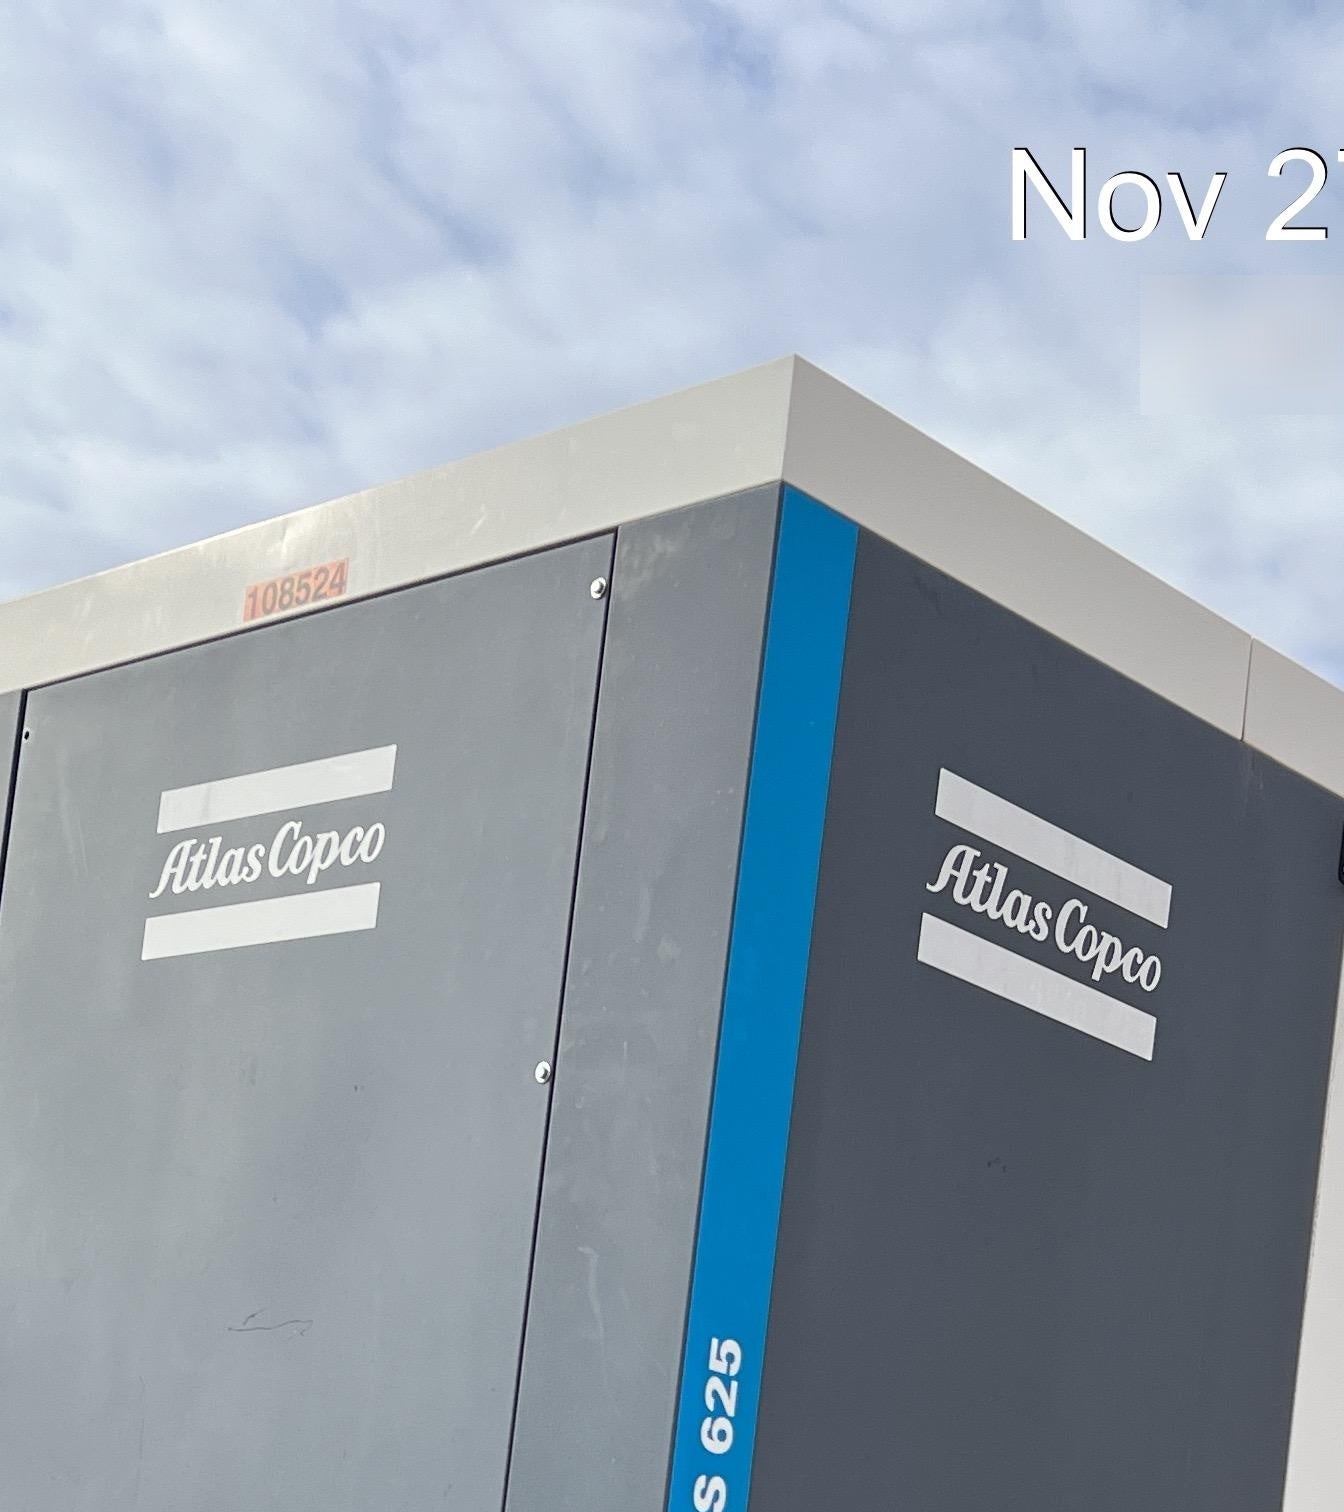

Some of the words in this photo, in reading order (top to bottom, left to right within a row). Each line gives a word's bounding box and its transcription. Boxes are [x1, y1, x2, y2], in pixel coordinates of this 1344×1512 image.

[246, 558, 348, 620] 108524
[148, 836, 265, 899] Atlas
[267, 820, 386, 885] Copco
[925, 843, 1053, 942] Atlas
[1054, 898, 1162, 992] Copco
[700, 1336, 743, 1455] 625
